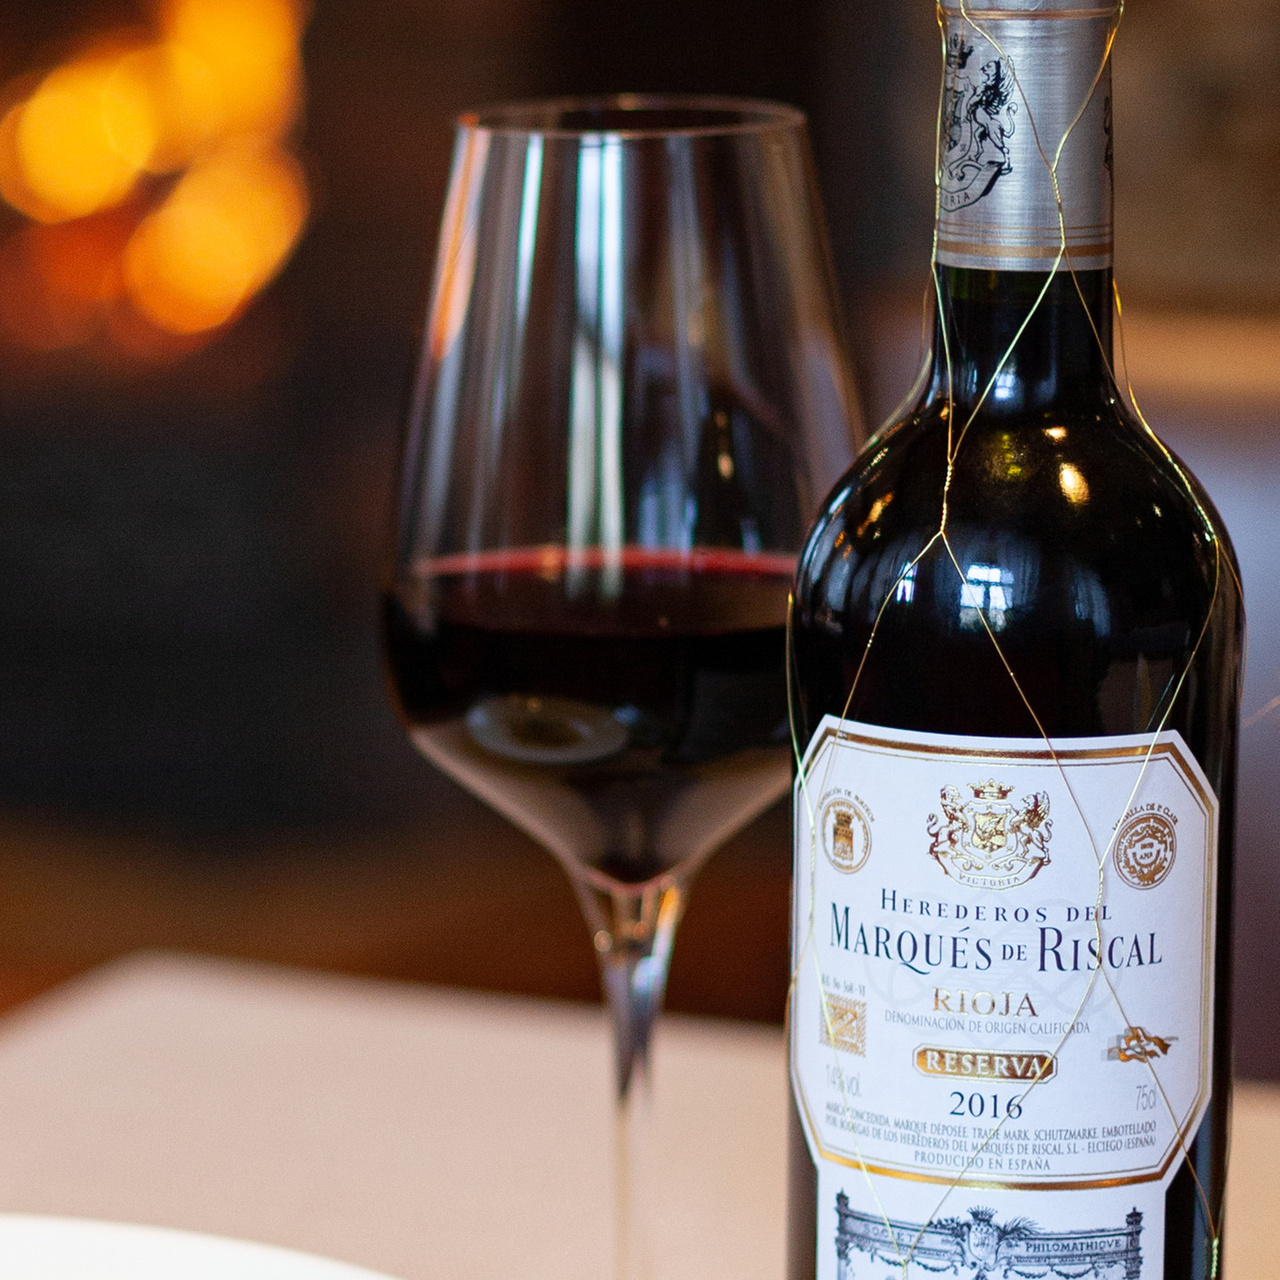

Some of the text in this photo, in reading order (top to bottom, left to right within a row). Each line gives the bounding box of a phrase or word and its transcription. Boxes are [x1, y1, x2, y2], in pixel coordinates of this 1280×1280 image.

[959, 874, 1020, 886] VICTORIA
[881, 887, 1111, 923] HEREDEROS DEL
[830, 902, 1162, 975] MARQUÉS DE RISCAL
[932, 987, 1038, 1018] RIOJA
[885, 1009, 1090, 1035] DENOMINACIÓN DE ORIGEN CALIFICADA
[925, 1051, 1043, 1076] RESERVA
[949, 1091, 1023, 1119] 2016
[872, 1127, 881, 1139] DE
[884, 1129, 898, 1142] LOS
[900, 1131, 949, 1151] HEREDEROS
[952, 1139, 968, 1152] DEL
[971, 1139, 1014, 1157] MARQUÉS
[1016, 1142, 1028, 1155] DE
[1087, 1139, 1123, 1153] ELCIEGO
[893, 1118, 928, 1137] MARQUE
[972, 1127, 1000, 1140] TRADE
[1102, 1120, 1157, 1137] EMBOTELLADO
[914, 1150, 1050, 1170] PRODUCIDO EN ESPAÑA
